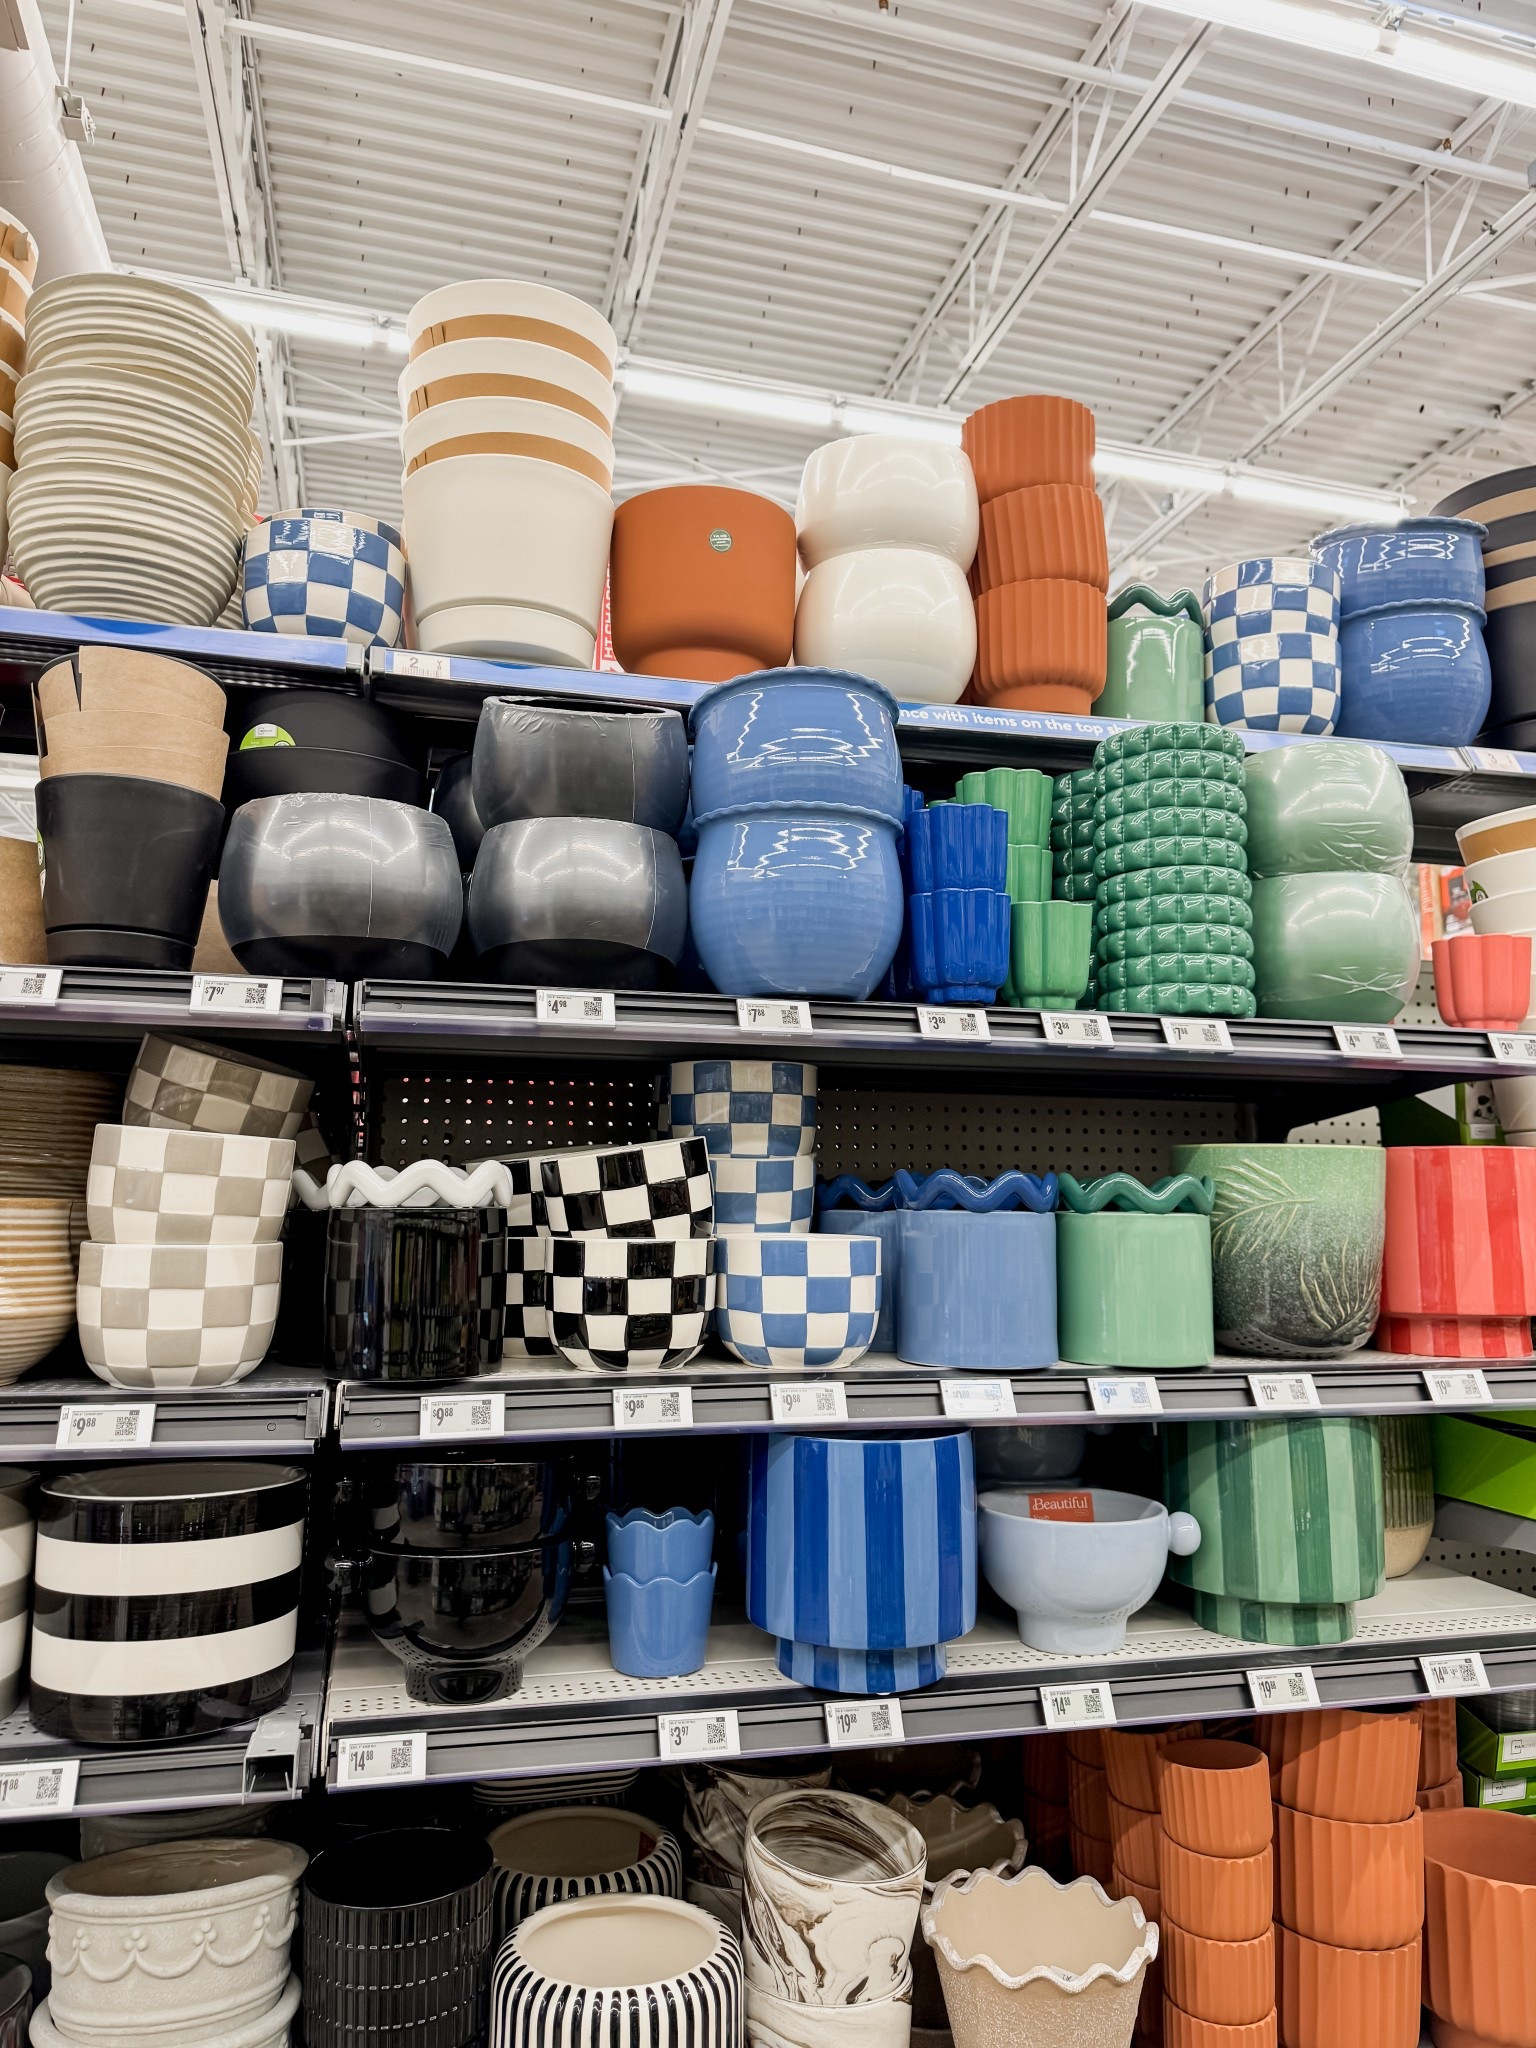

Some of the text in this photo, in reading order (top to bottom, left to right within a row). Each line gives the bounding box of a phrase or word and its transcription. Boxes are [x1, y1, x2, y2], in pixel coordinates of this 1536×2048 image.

[933, 710, 969, 724] with
[972, 712, 1018, 728] items
[1021, 719, 1043, 730] on
[1045, 719, 1073, 732] the
[1076, 721, 1104, 736] top
[1032, 1496, 1088, 1511] Beautiful
